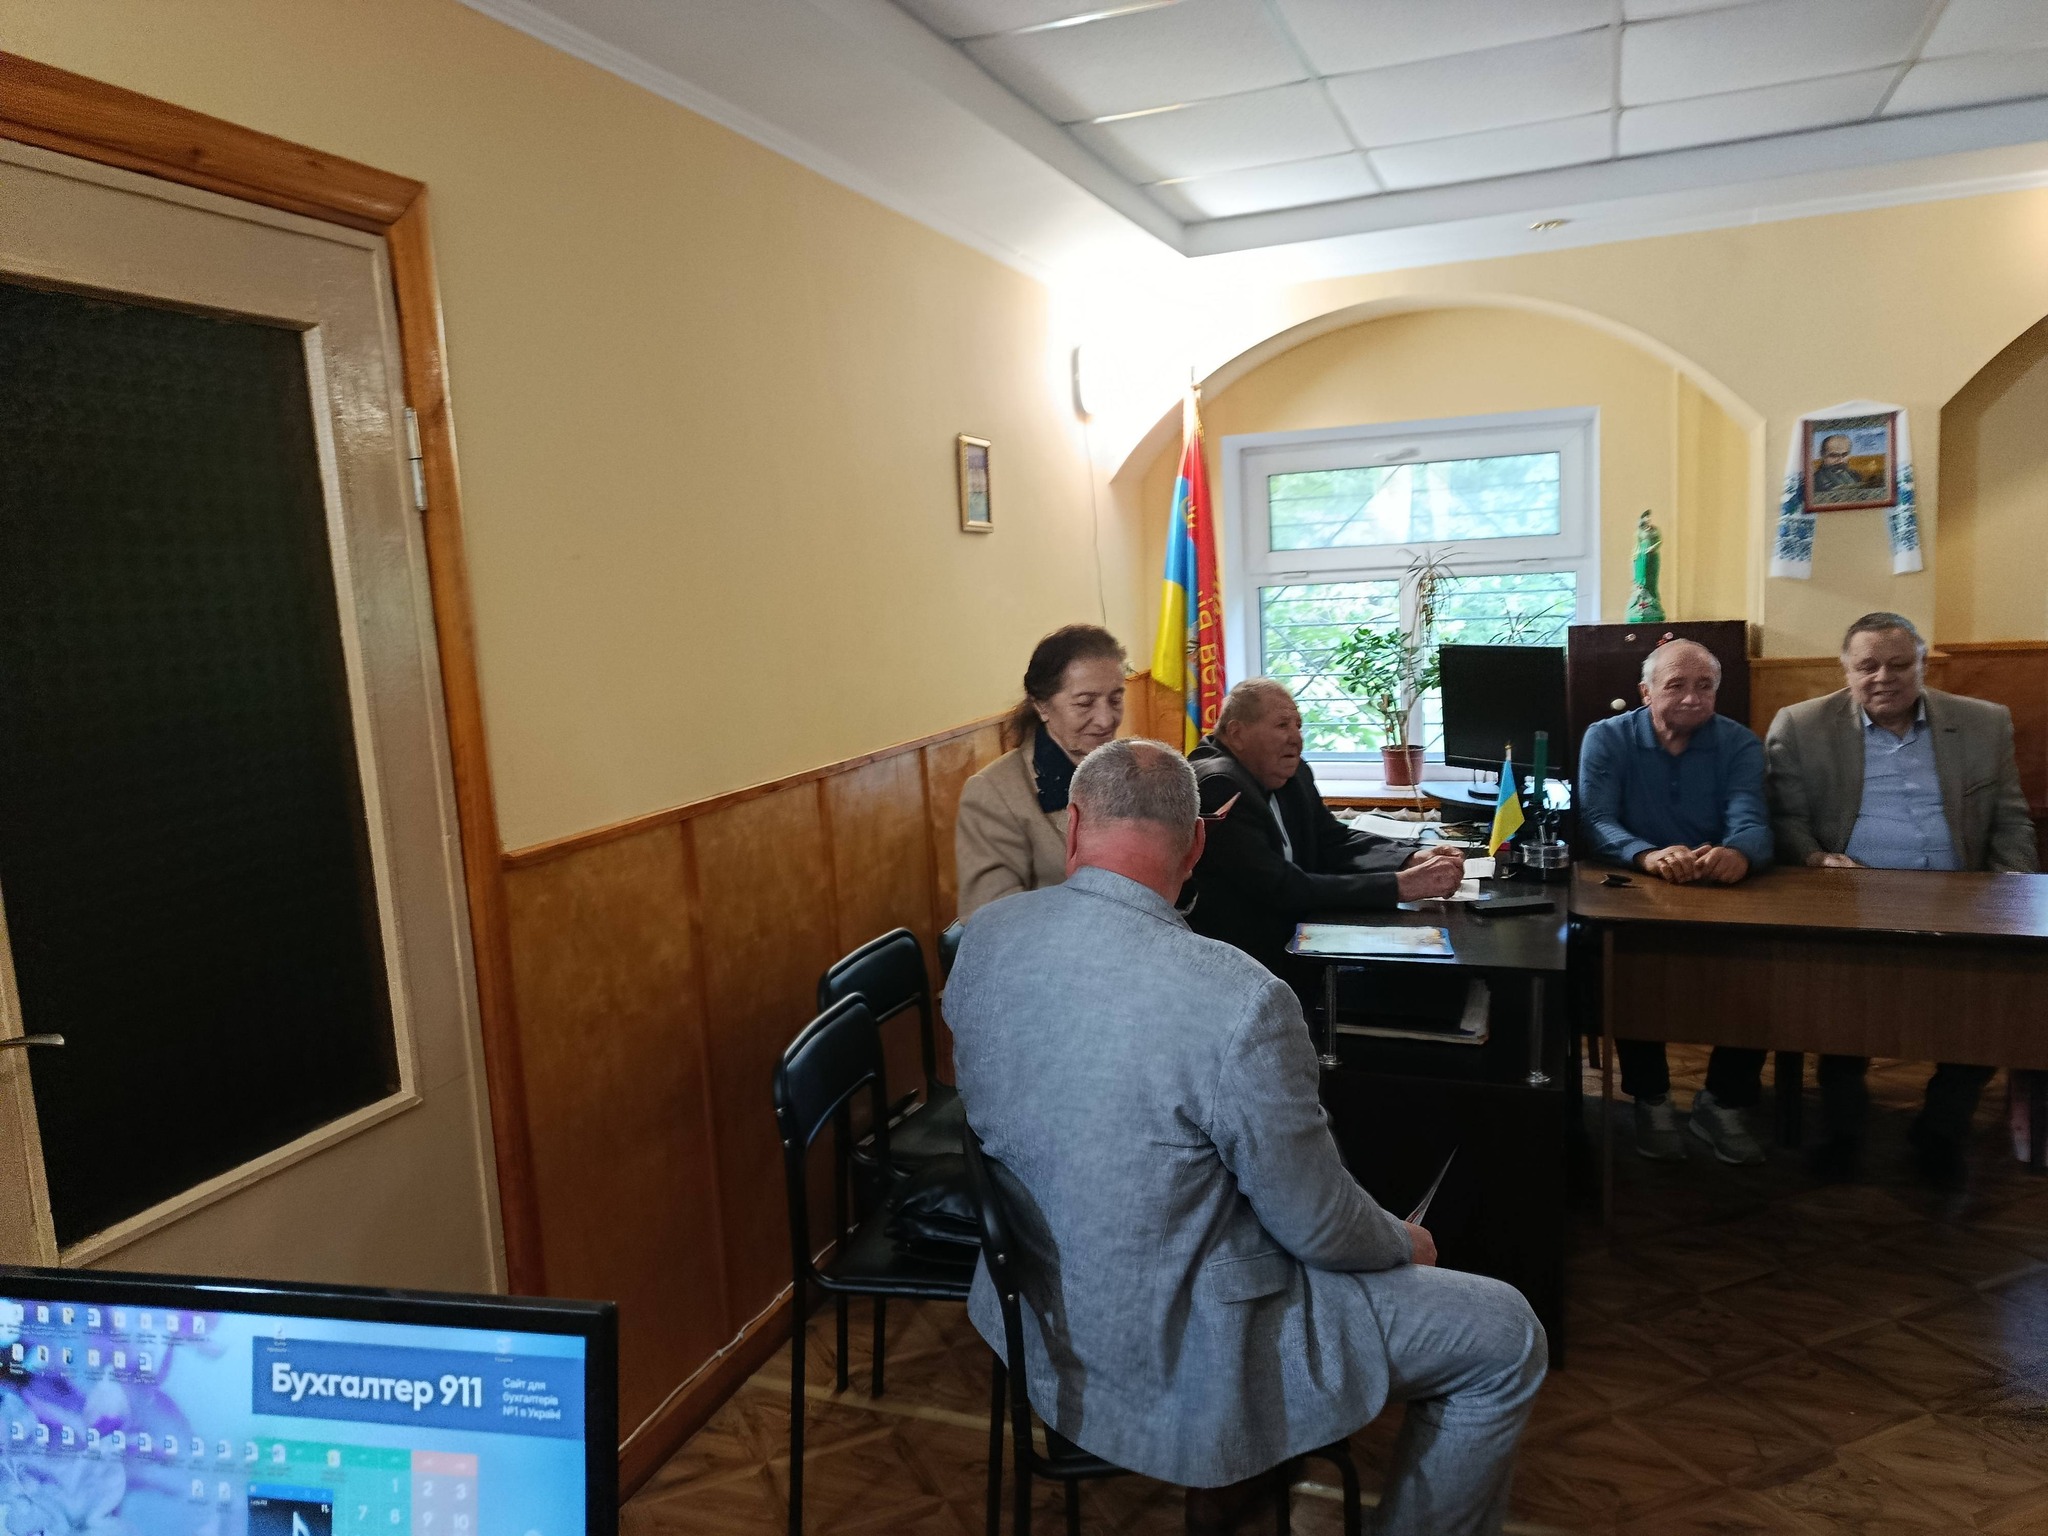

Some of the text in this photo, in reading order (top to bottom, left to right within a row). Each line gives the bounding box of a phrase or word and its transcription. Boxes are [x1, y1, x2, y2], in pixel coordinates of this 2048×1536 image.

[272, 1362, 482, 1411] Бухгалтер 911
[502, 1377, 546, 1392] Сайт для
[423, 1480, 433, 1497] 2
[456, 1483, 467, 1500] 3
[358, 1505, 470, 1530] 7 8 9 10
